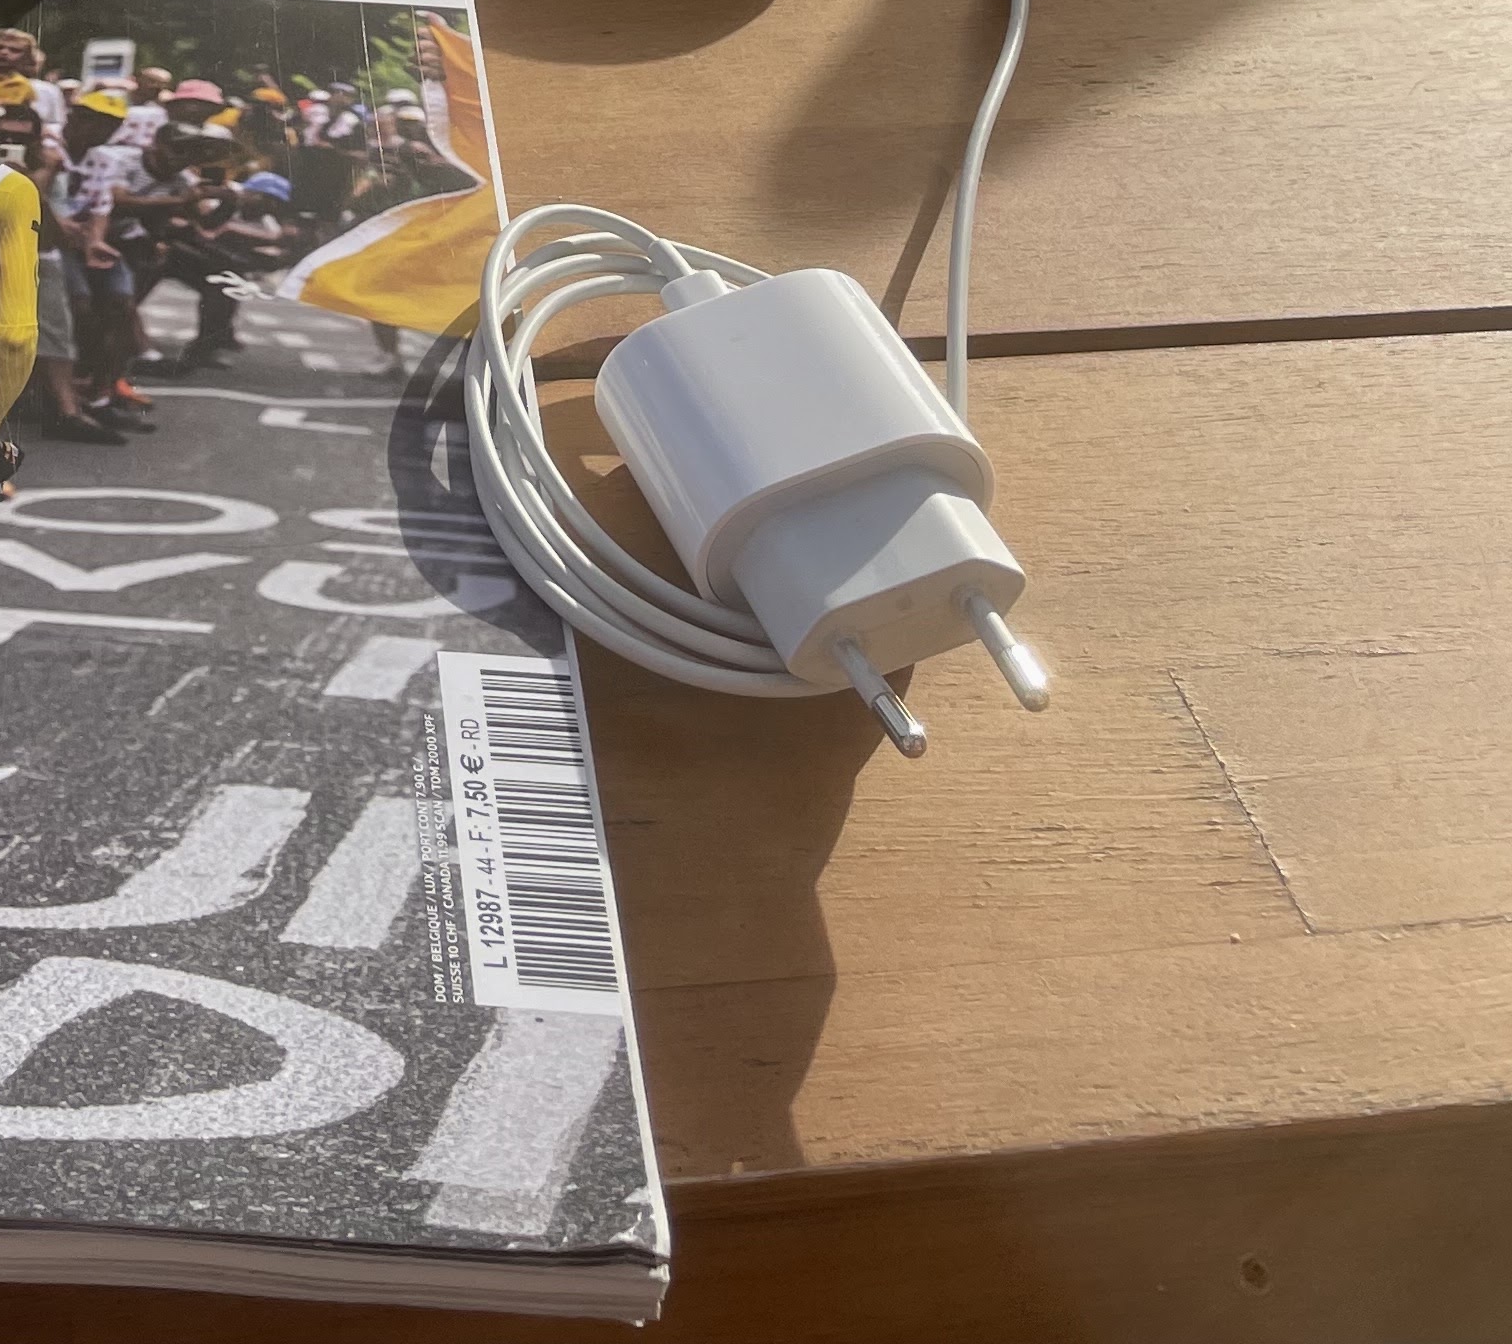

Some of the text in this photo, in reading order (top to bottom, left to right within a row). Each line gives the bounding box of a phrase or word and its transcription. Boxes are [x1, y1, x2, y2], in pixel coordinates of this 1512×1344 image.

[423, 714, 436, 734] XPF
[460, 718, 481, 742] RD
[426, 736, 440, 765] 2000
[460, 753, 485, 775] €
[429, 766, 443, 790] TOM
[462, 780, 494, 818] 7,50
[419, 830, 433, 862] PORT
[475, 857, 497, 876] 44
[423, 872, 436, 896] LUX
[439, 861, 454, 909] CANADA
[475, 887, 507, 949] 12987
[427, 905, 443, 963] BELGIQUE
[444, 919, 458, 943] CHF
[447, 946, 460, 959] 10
[483, 956, 508, 969] L
[433, 973, 447, 1003] DOM
[449, 961, 465, 1004] SUISSE
